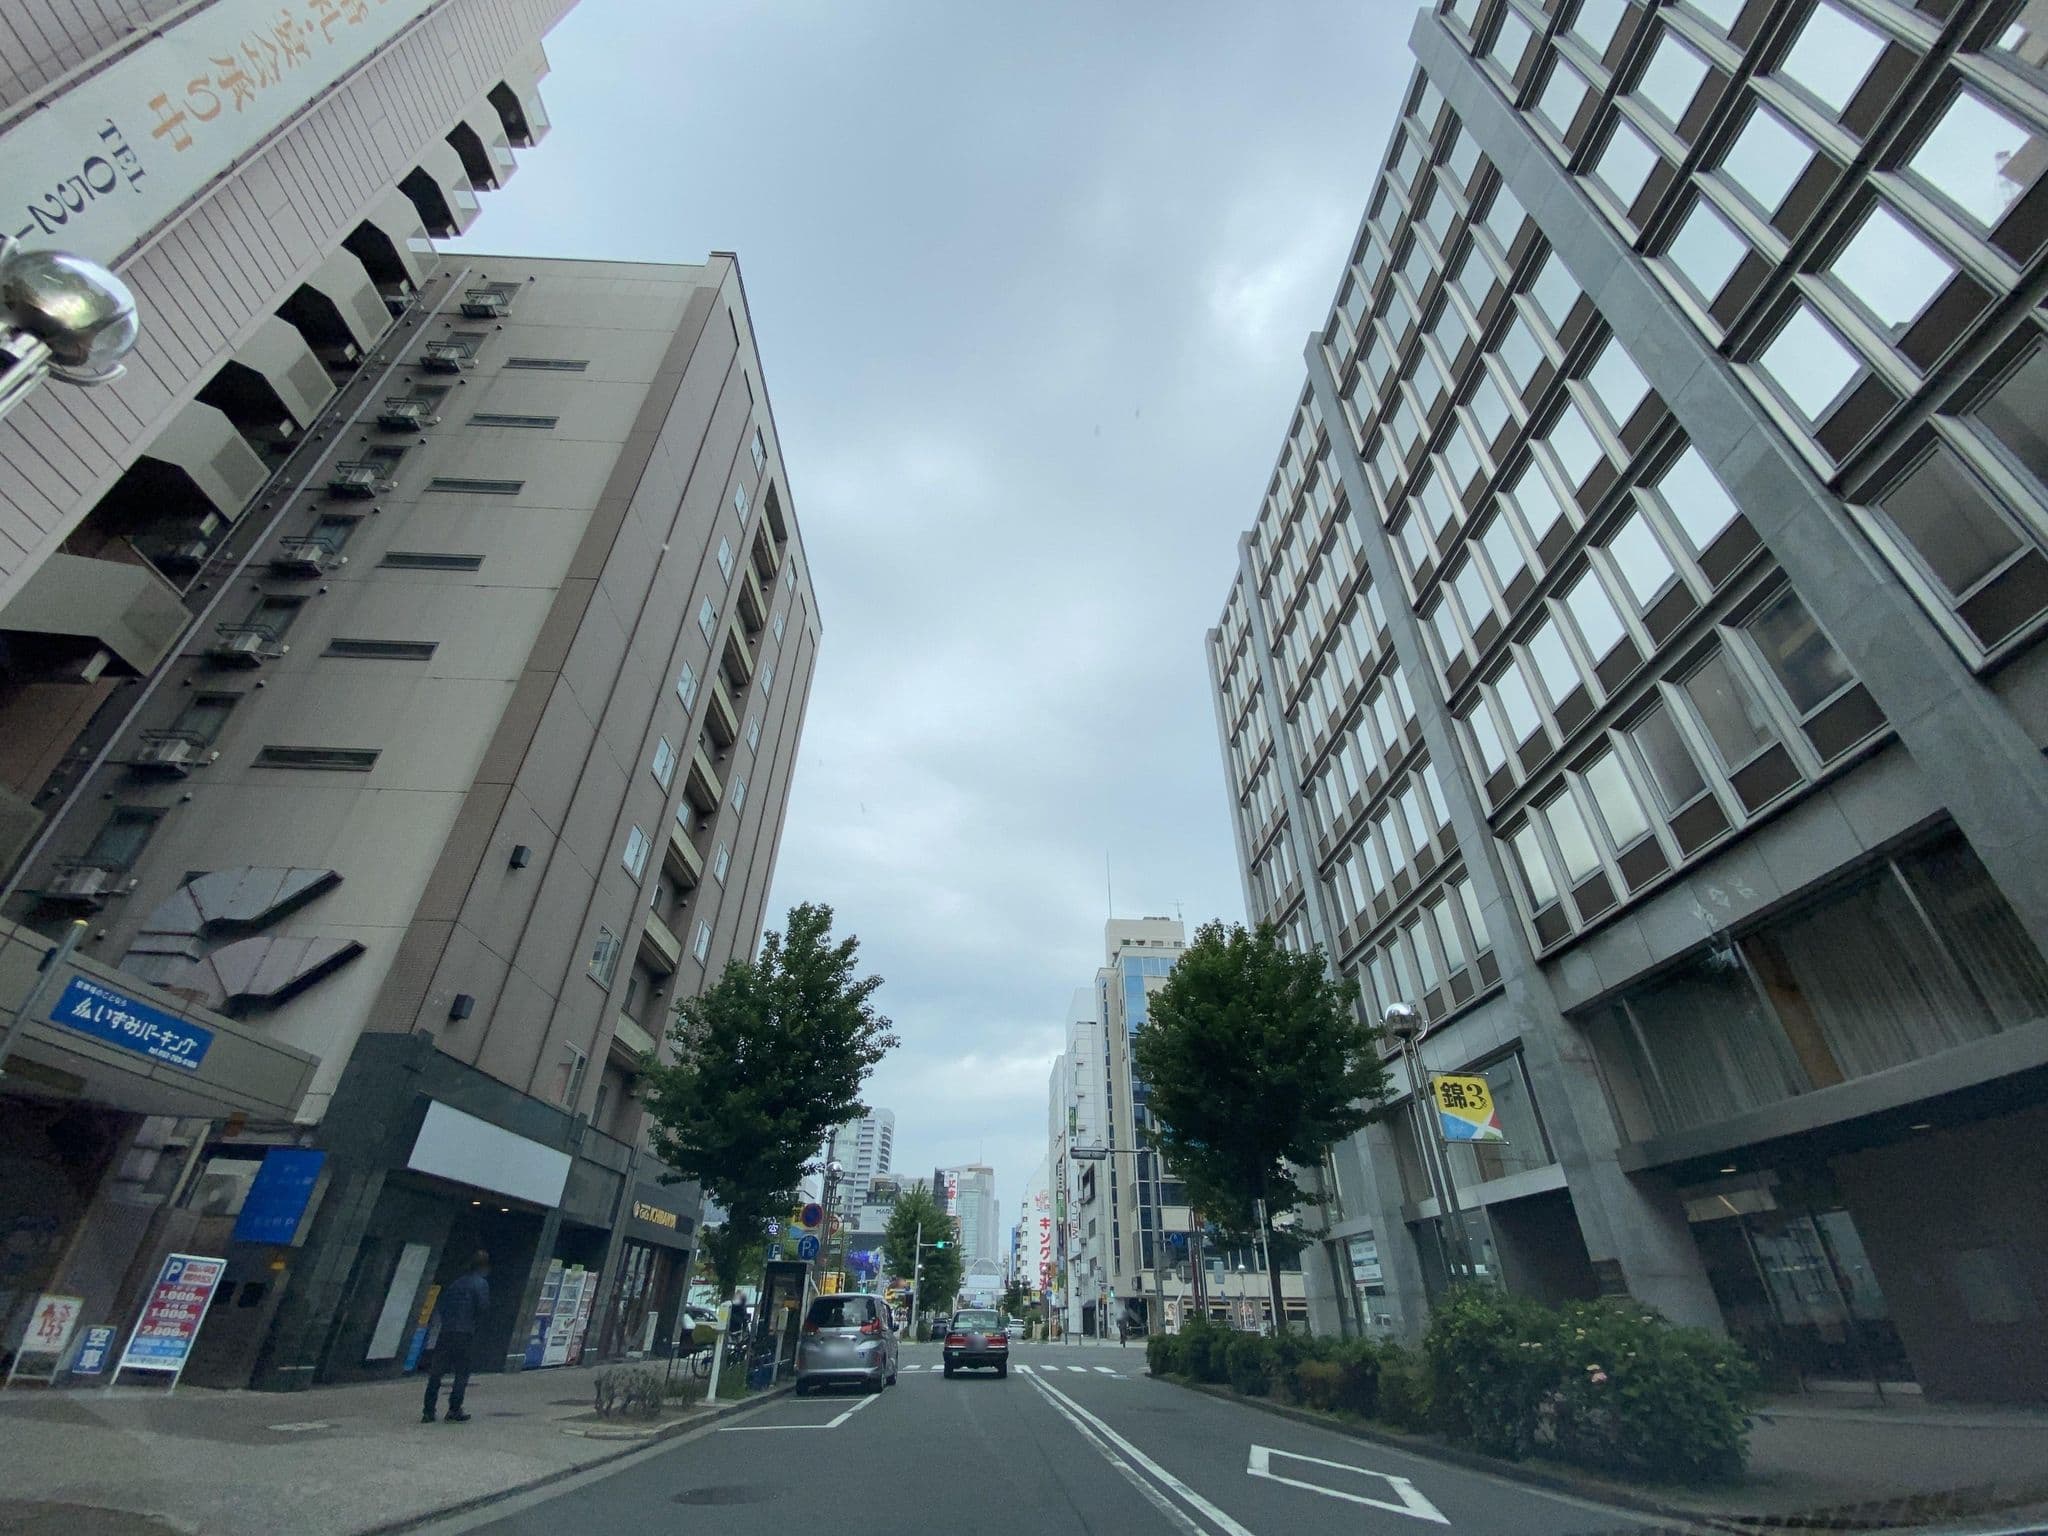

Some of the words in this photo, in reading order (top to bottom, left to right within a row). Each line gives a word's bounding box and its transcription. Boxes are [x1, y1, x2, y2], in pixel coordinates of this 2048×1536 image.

[97, 118, 147, 193] TEL
[1071, 1200, 1079, 1239] WELLA
[802, 1241, 812, 1257] P
[165, 1260, 183, 1282] P
[79, 1328, 111, 1369] 空車
